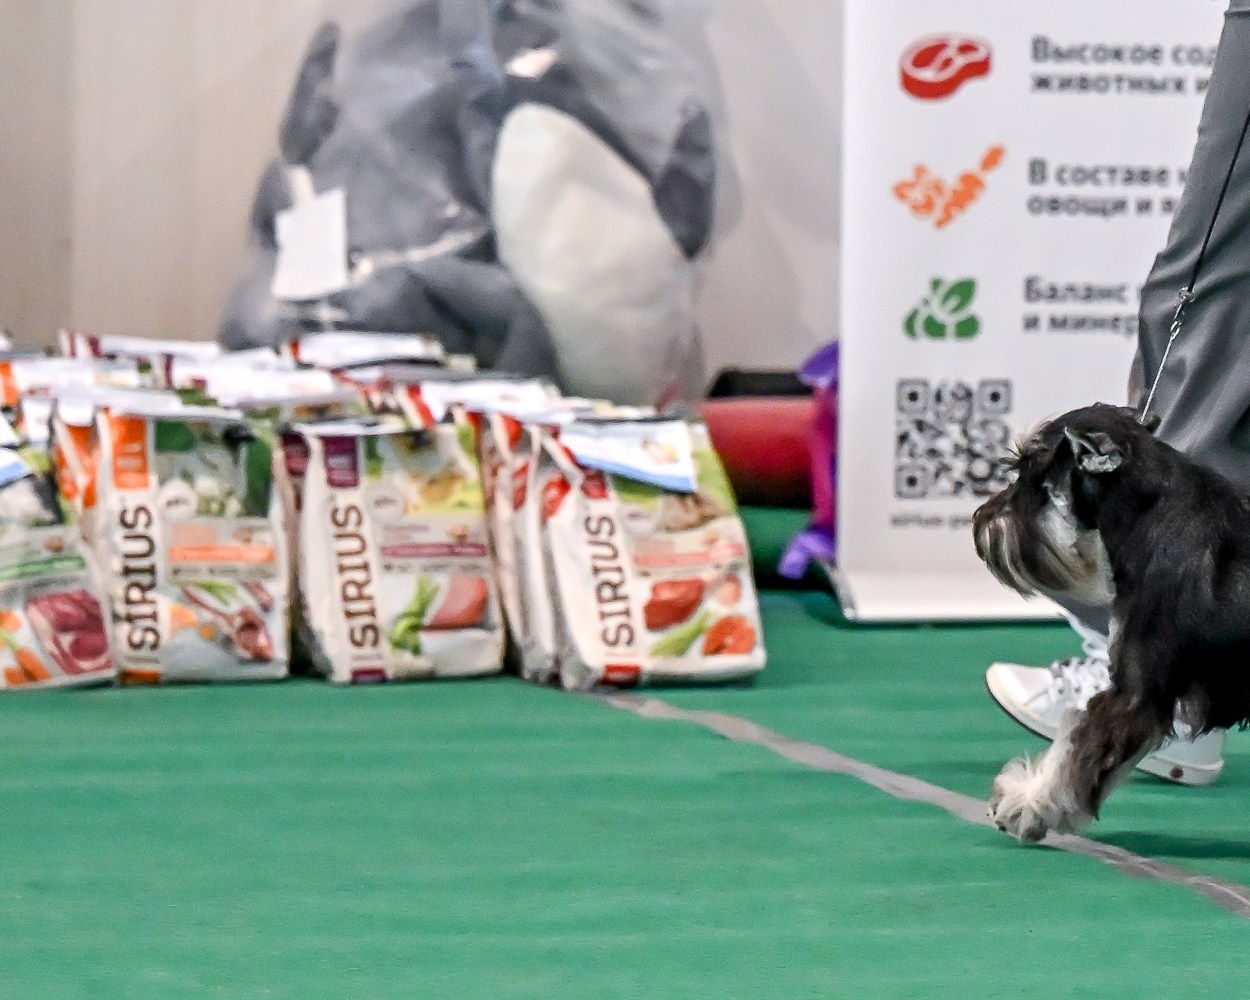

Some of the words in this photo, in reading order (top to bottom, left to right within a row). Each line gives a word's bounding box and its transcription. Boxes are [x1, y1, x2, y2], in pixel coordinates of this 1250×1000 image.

[1031, 34, 1164, 66] Высокое
[1031, 72, 1187, 95] животных
[1029, 157, 1047, 185] В
[1055, 164, 1171, 187] составе
[1027, 196, 1129, 219] овощи
[1136, 198, 1152, 216] и
[1024, 275, 1128, 304] Баланс
[1023, 313, 1039, 333] и
[119, 505, 161, 651] SIRIUS
[331, 504, 381, 647] SIRIUS
[584, 515, 635, 647] SIRIUS
